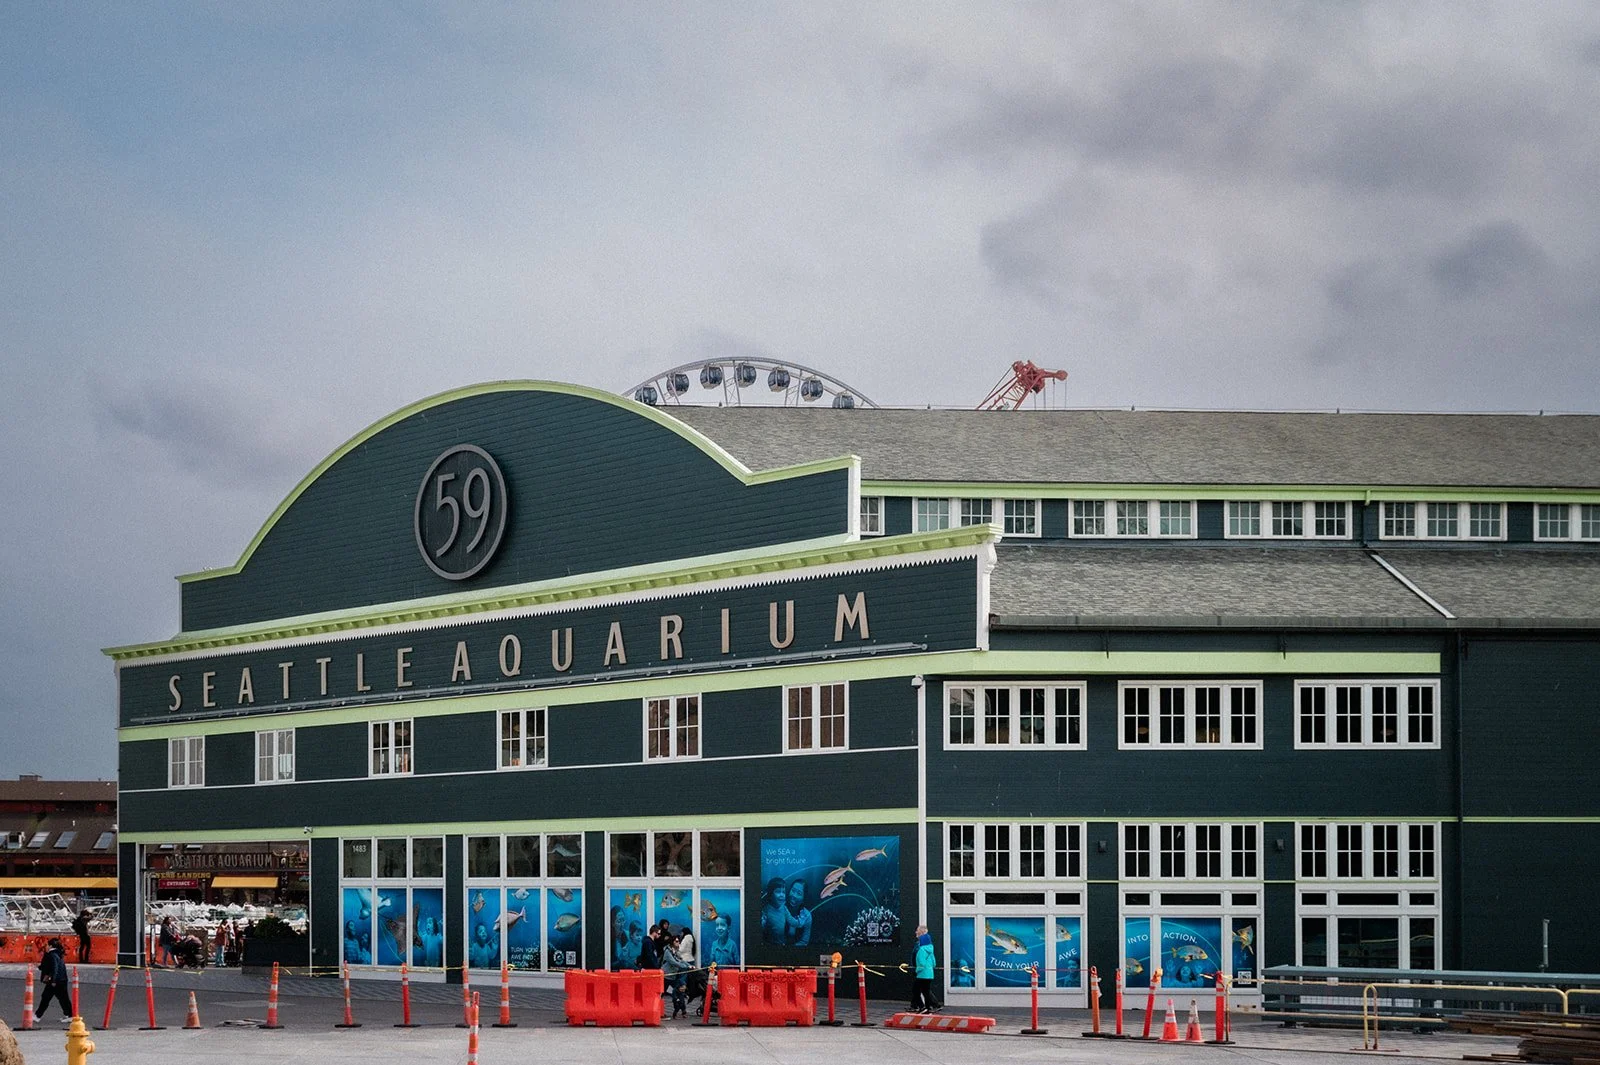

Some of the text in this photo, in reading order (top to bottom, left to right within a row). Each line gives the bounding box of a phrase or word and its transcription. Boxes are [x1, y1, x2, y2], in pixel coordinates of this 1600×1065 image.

[436, 467, 491, 558] 59
[168, 591, 870, 712] SEATTLE AQUARIUM
[352, 844, 367, 853] 1483
[777, 847, 791, 856] SEA
[217, 854, 273, 868] AQUARIUM
[765, 857, 807, 866] bright future
[1127, 931, 1198, 944] INTO ACTION.
[989, 947, 1078, 970] TURN YOUR AWE
